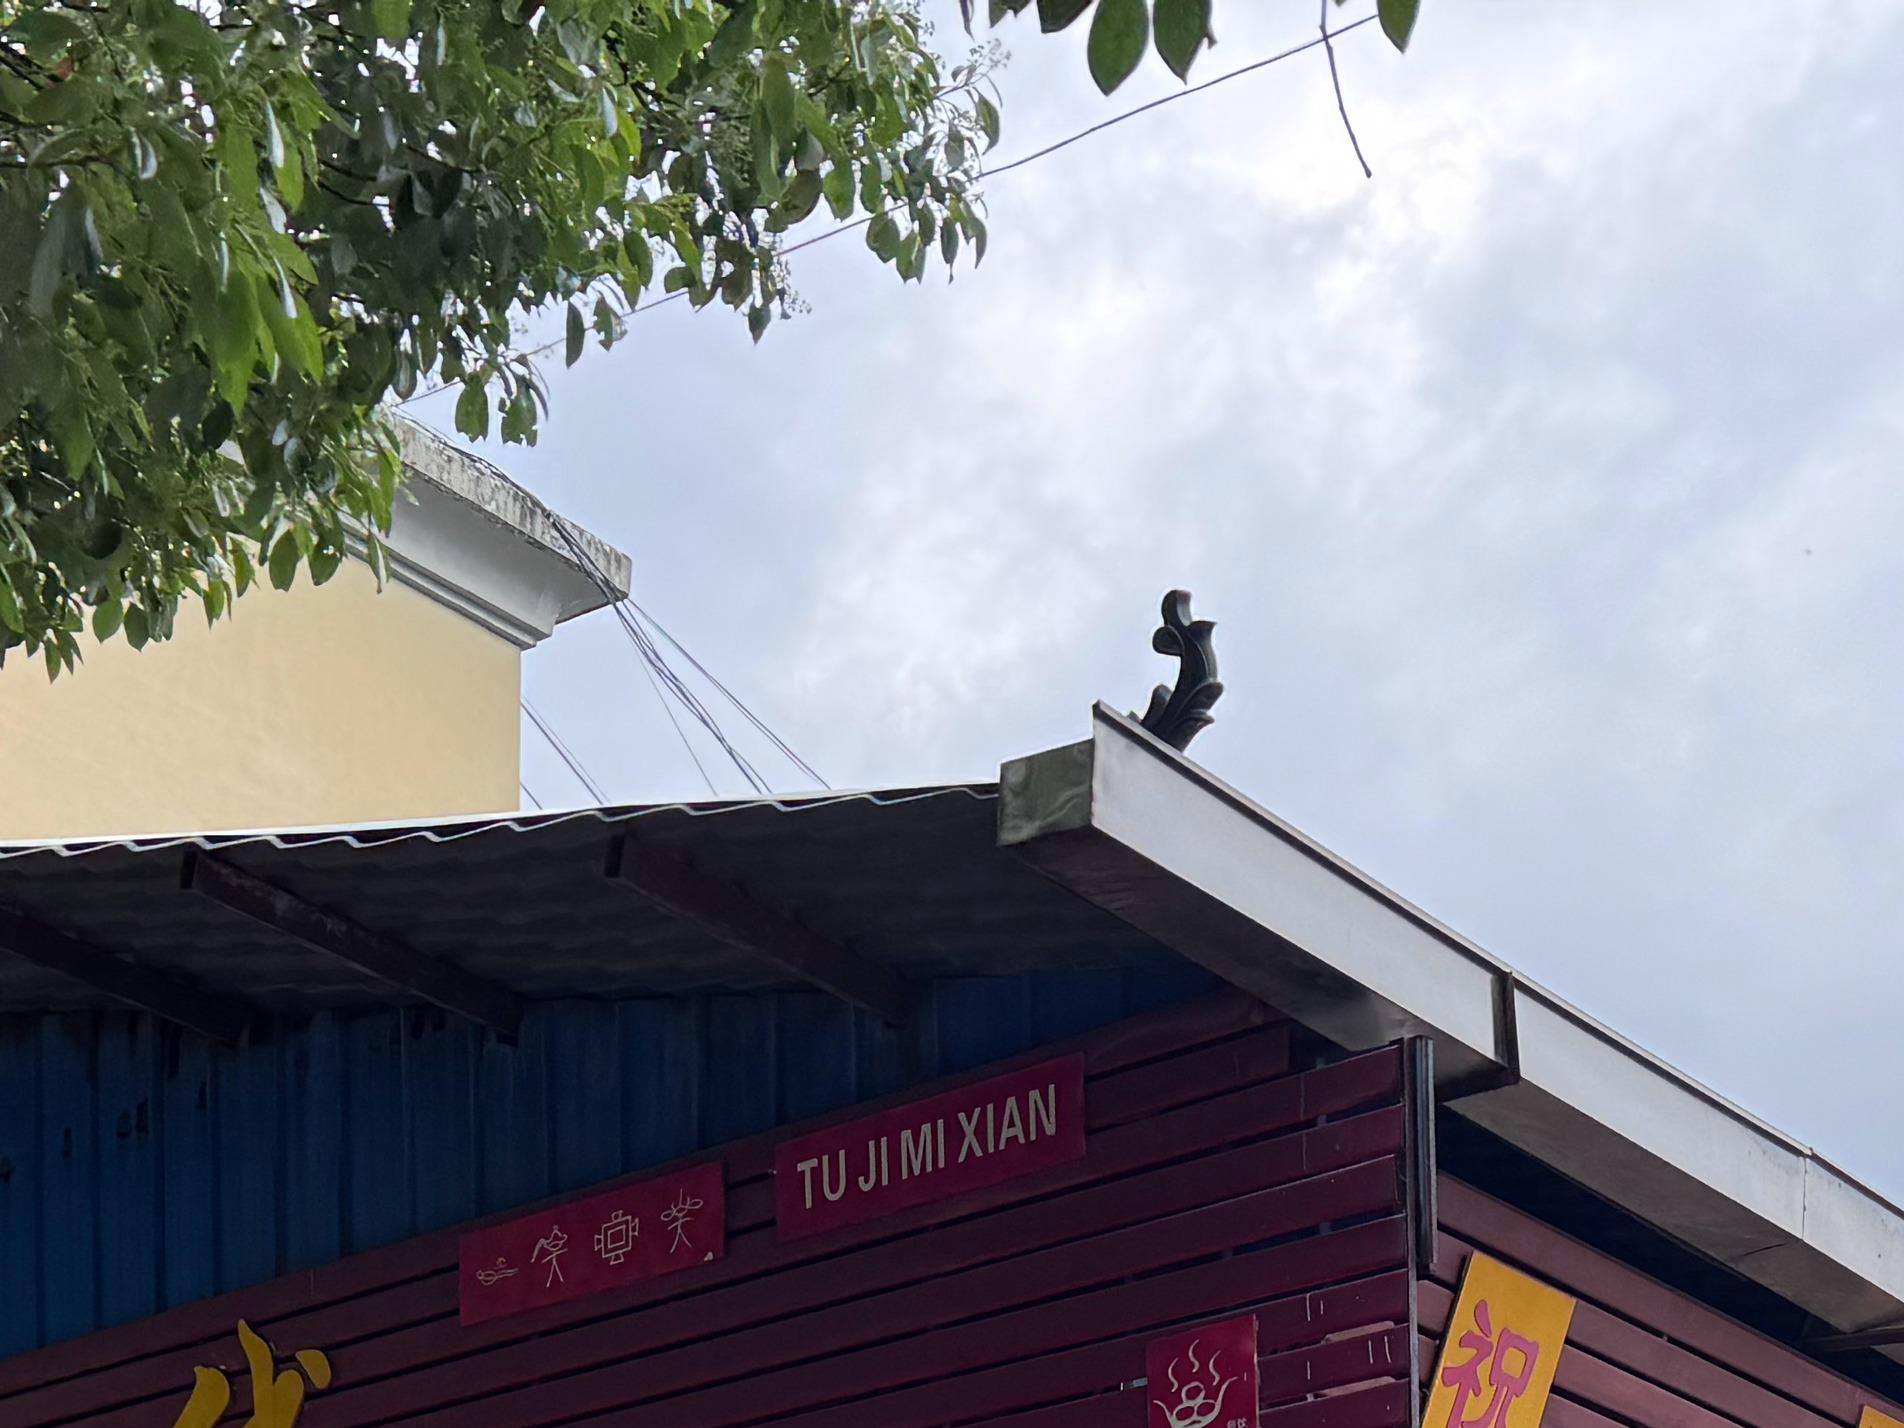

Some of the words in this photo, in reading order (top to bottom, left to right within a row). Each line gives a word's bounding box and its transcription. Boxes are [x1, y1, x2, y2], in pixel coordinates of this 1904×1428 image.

[796, 1151, 847, 1210] TU
[857, 1136, 889, 1192] JI
[901, 1118, 945, 1180] MI
[957, 1083, 1057, 1164] XIAN
